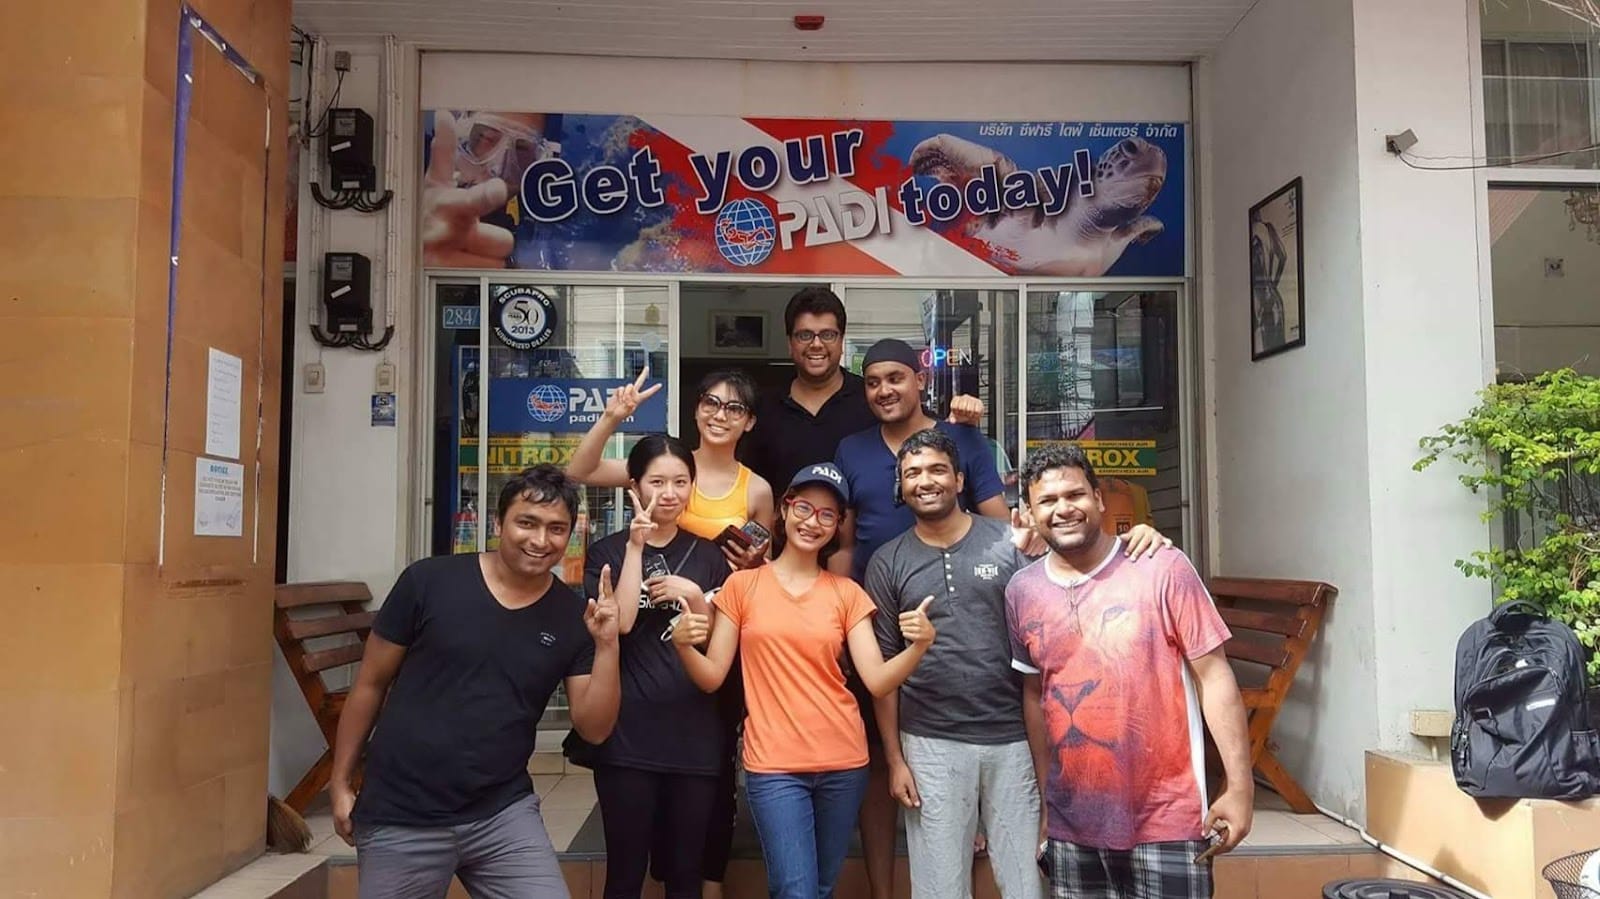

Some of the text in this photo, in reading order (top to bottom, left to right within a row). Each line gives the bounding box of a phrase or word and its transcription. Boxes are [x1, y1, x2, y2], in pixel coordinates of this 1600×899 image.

[520, 128, 1095, 250] Get your PADI today!
[498, 287, 550, 306] SCUBAPRO
[514, 300, 539, 325] 50
[511, 325, 535, 335] 2013
[921, 348, 972, 367] OPEN
[812, 466, 842, 484] PADI
